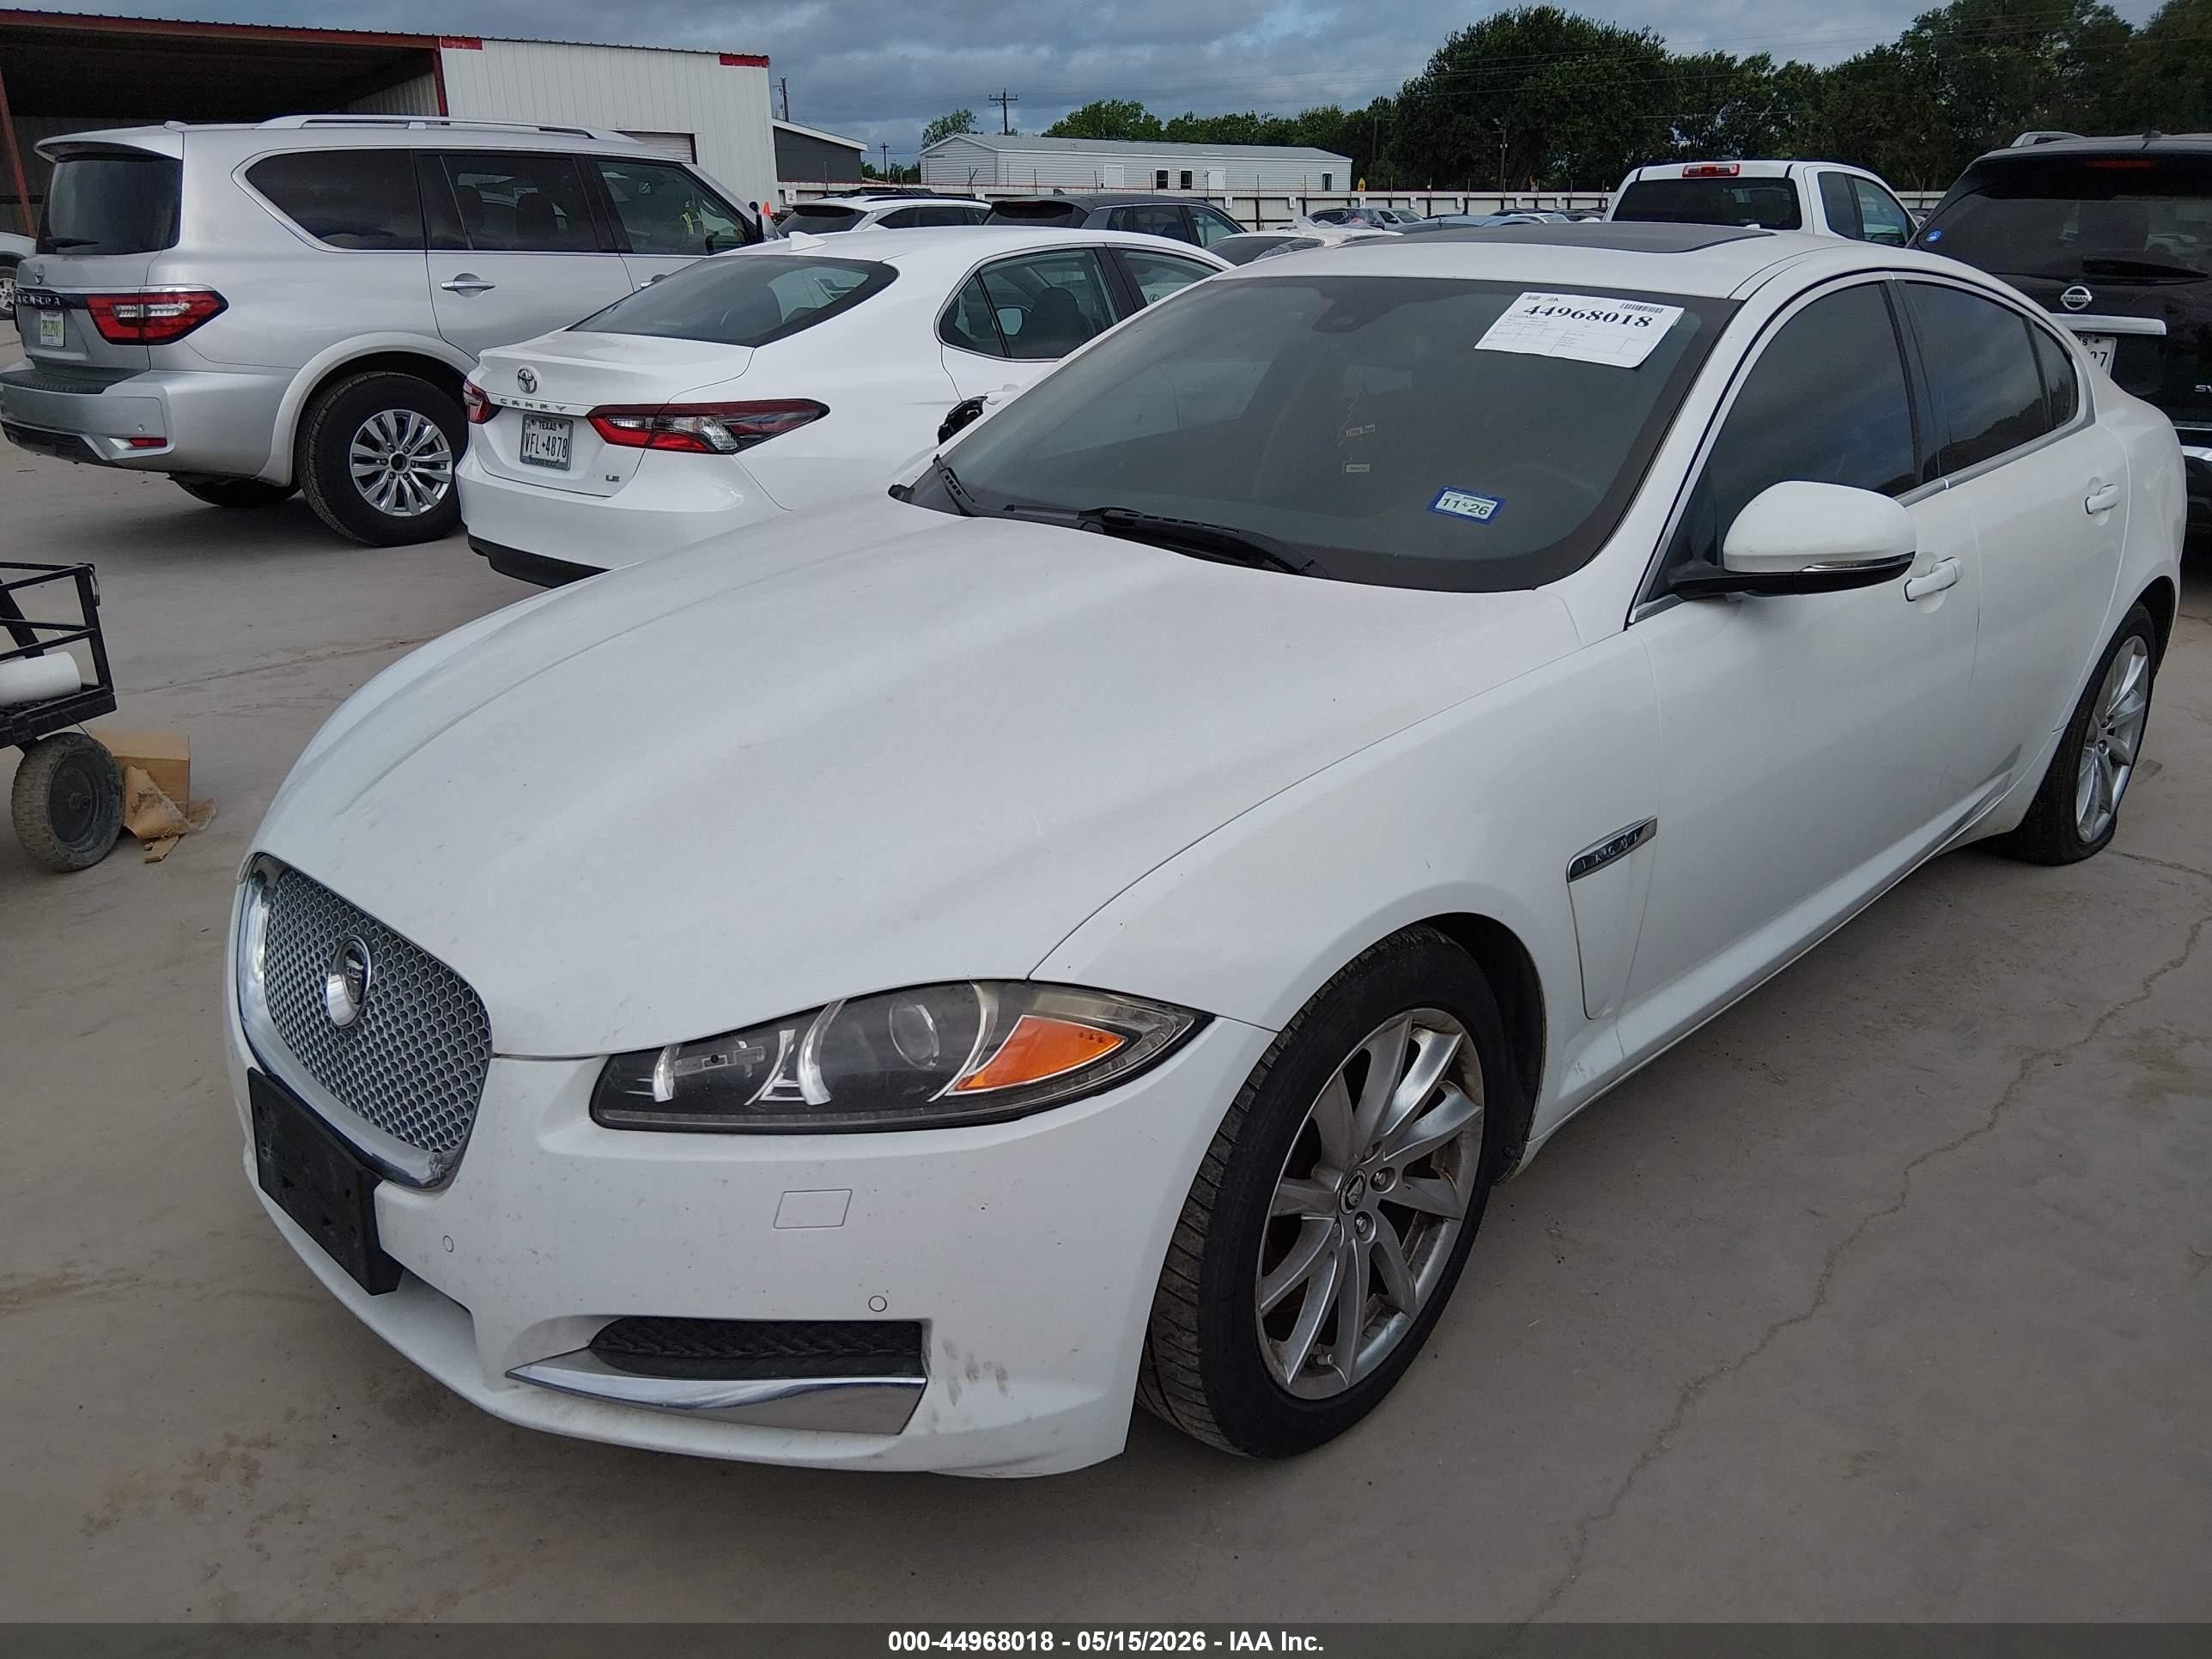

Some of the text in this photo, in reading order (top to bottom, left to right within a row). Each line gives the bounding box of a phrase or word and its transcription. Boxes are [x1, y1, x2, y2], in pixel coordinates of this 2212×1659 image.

[1523, 304, 1654, 328] 44968018
[500, 398, 567, 412] CAMRY
[538, 418, 557, 431] TEXAS
[605, 474, 620, 483] LE
